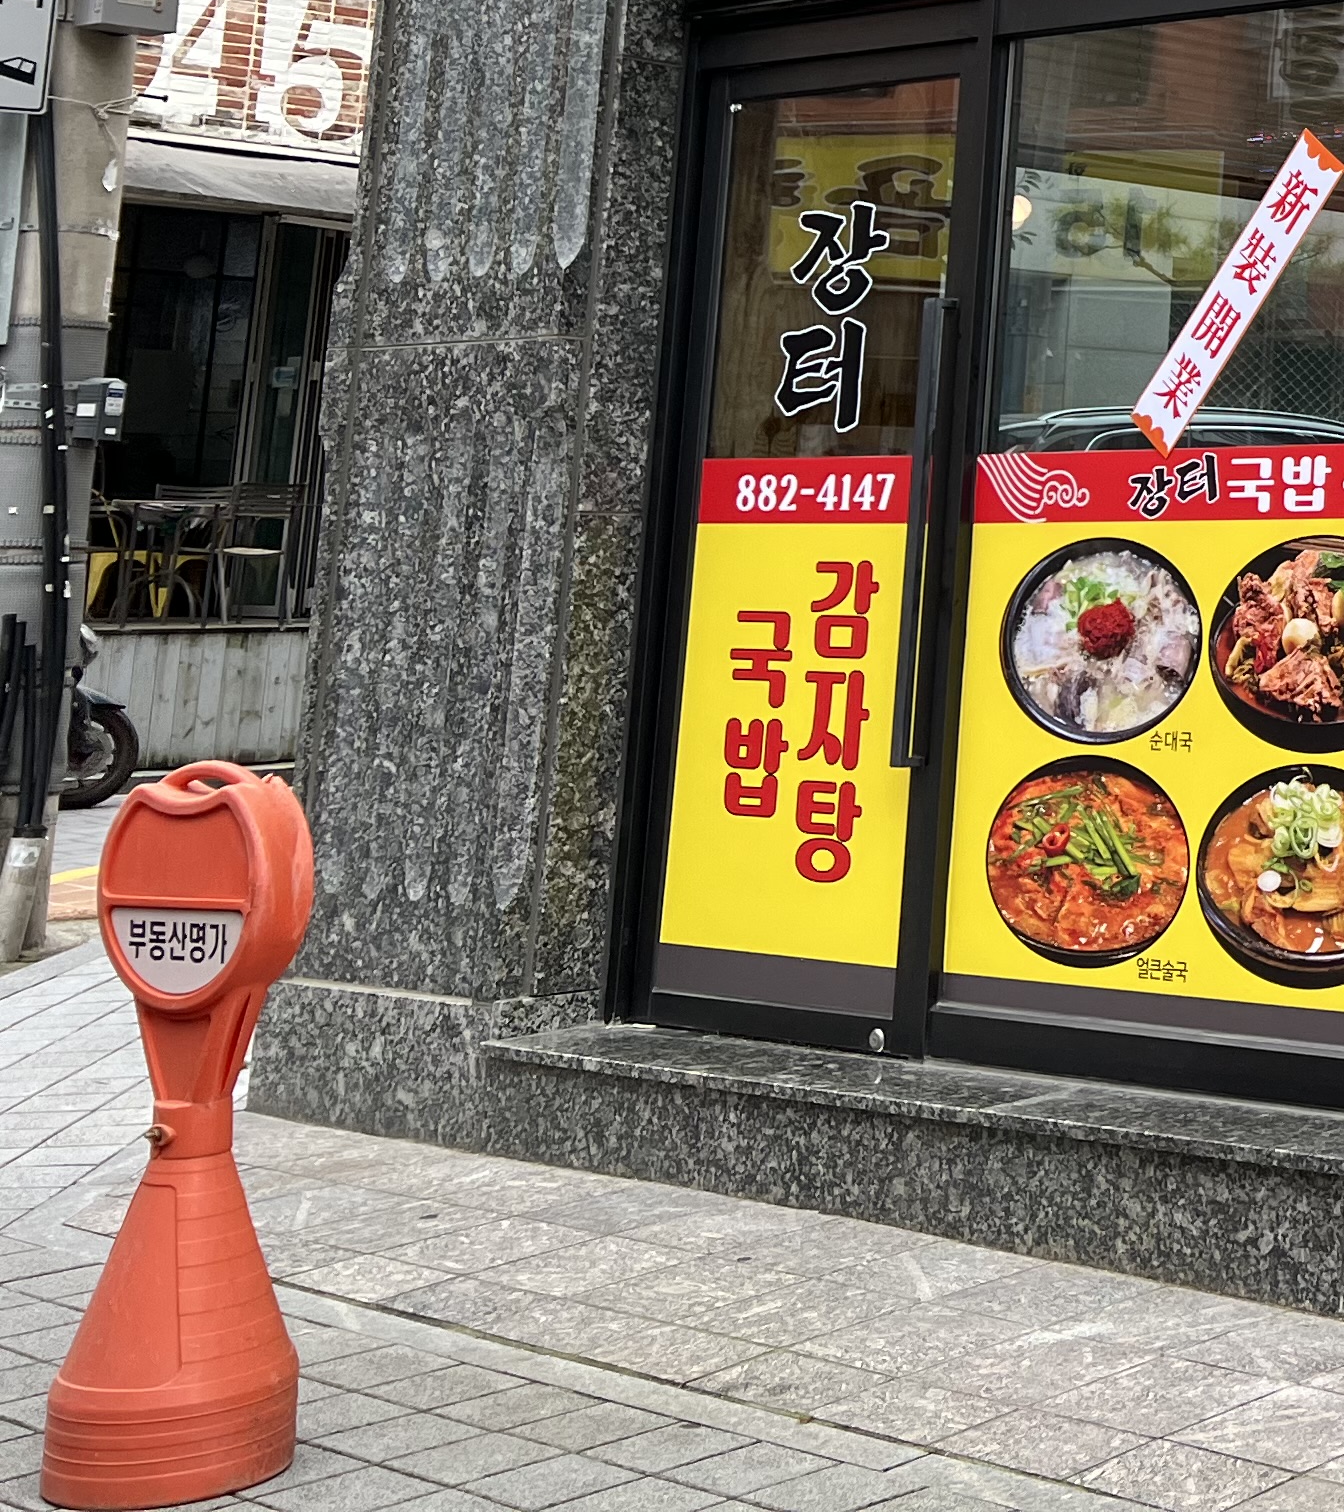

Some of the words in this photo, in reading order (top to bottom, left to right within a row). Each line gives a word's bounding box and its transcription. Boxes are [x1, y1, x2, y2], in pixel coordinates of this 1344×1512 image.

[775, 200, 890, 433] 장터
[1153, 168, 1315, 420] 新裝開業
[736, 473, 896, 512] 882-4147
[1128, 452, 1221, 520] 장터
[724, 610, 793, 819] 국밥
[795, 560, 880, 883] 감자탕
[1149, 729, 1194, 754] 순대국
[128, 919, 227, 965] 부동산명가
[1136, 955, 1189, 983] 얼큰술국
